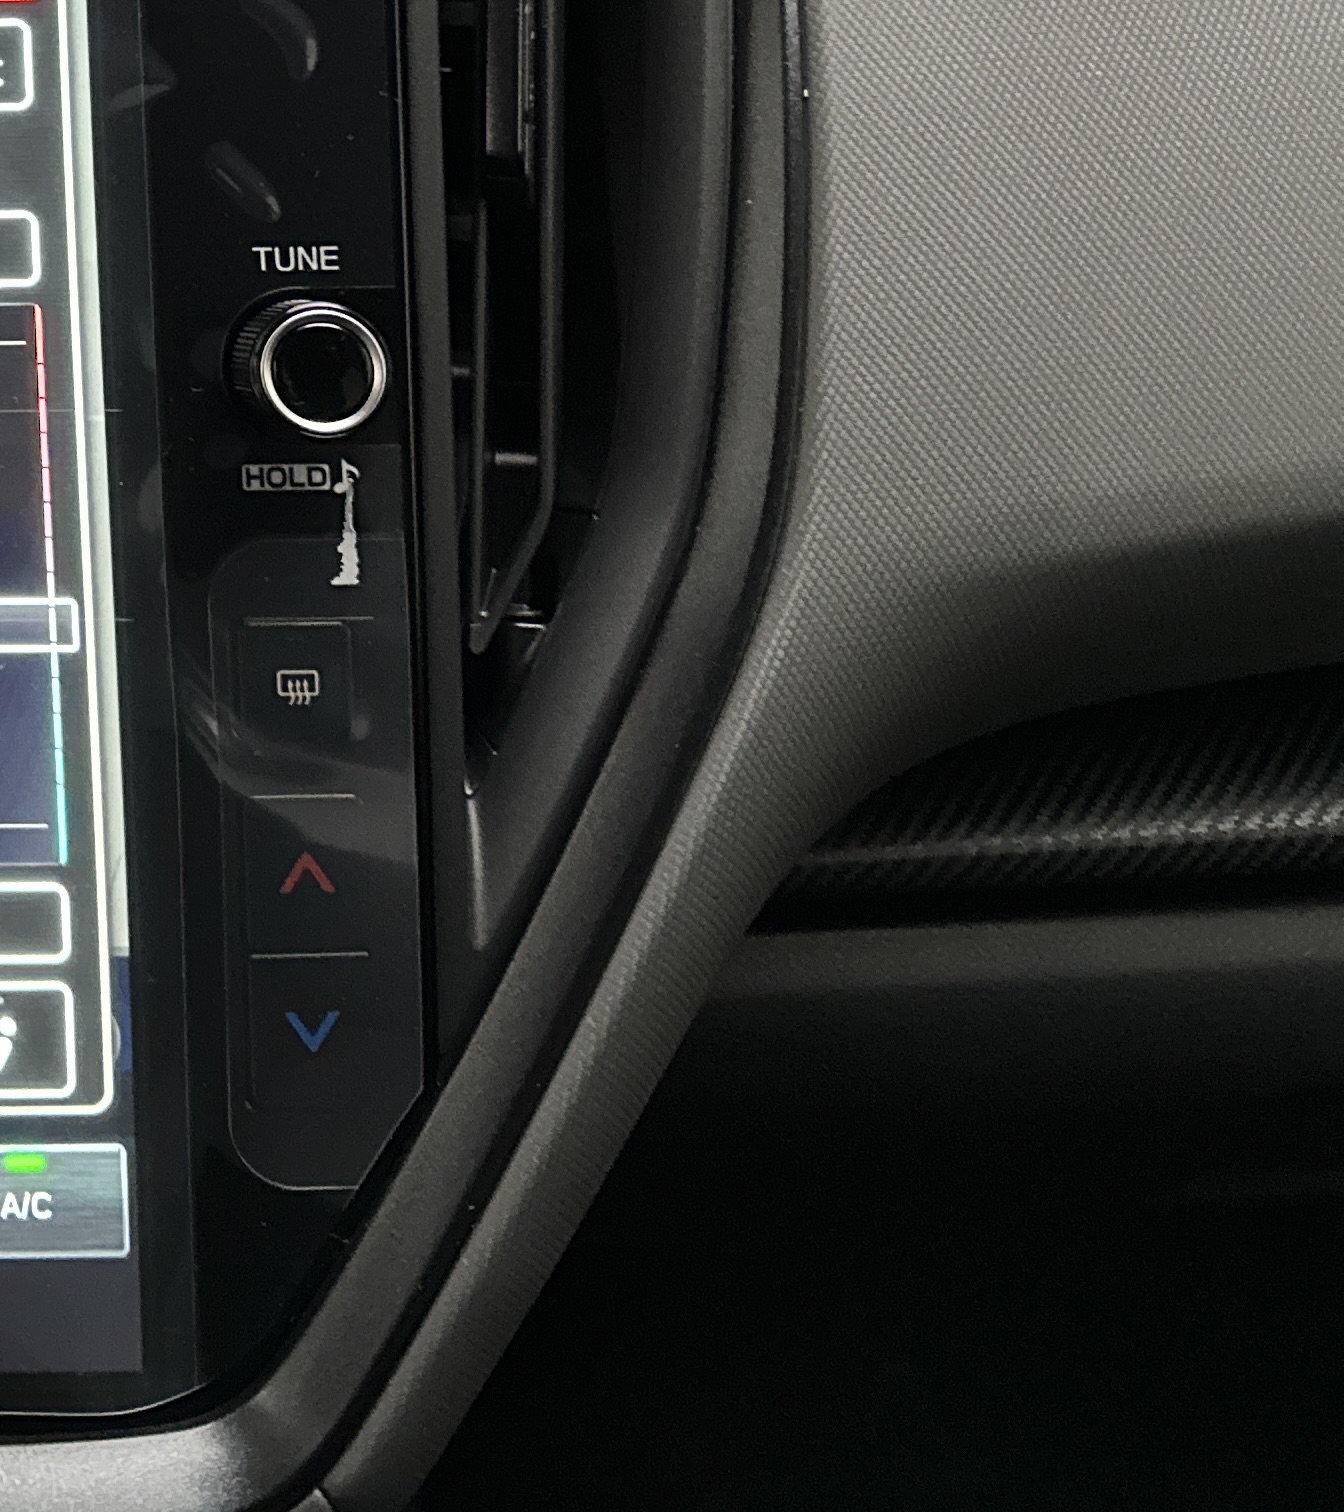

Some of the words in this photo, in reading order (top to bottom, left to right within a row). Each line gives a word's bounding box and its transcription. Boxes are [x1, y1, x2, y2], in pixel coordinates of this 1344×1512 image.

[251, 245, 340, 272] TUNE
[243, 465, 328, 488] HOLD
[0, 1190, 53, 1222] A/C
